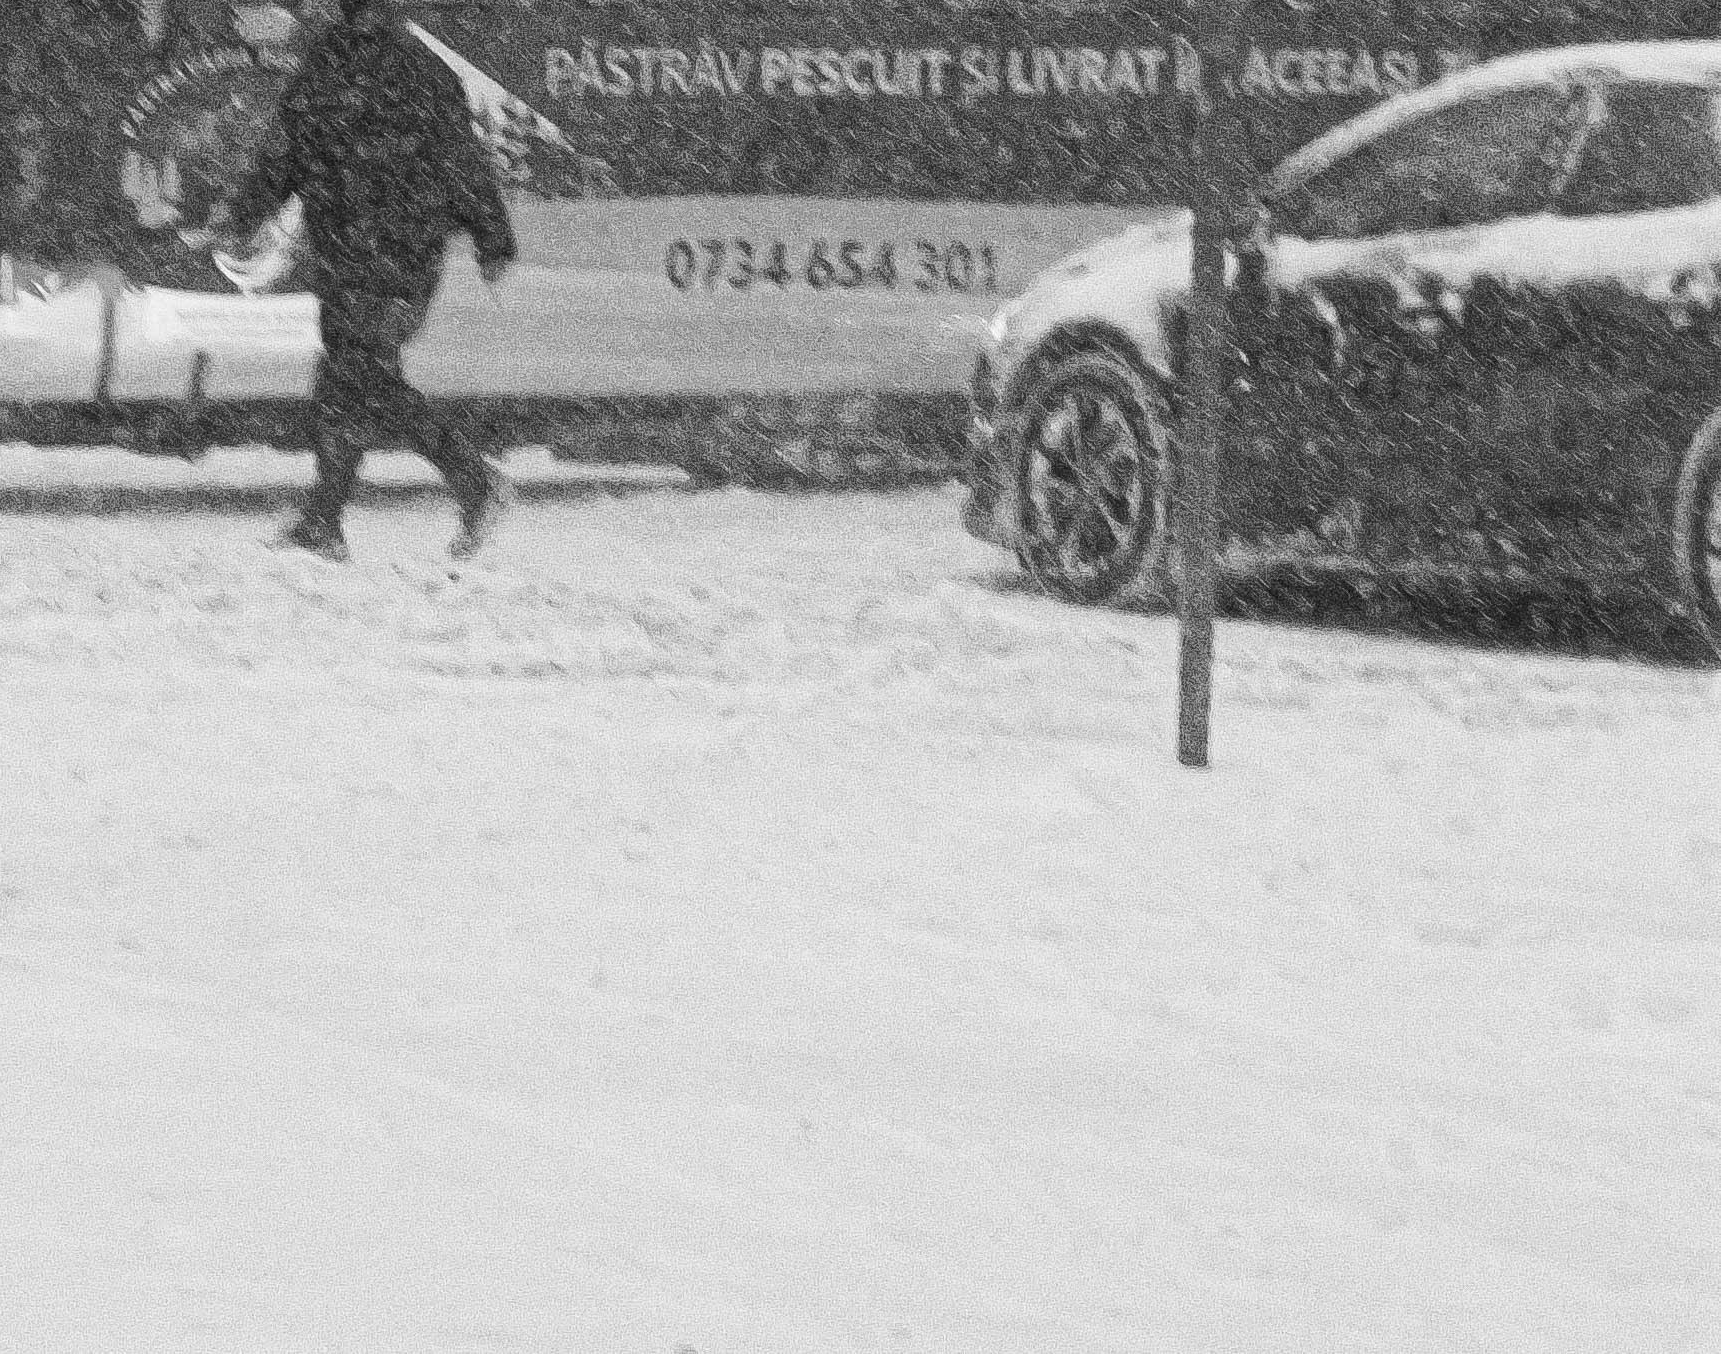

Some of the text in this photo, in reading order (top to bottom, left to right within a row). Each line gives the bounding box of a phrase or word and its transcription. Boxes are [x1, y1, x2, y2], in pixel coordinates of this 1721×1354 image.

[544, 37, 752, 95] PĂSTRĂV
[761, 45, 949, 95] PESCUIT
[1006, 46, 1168, 96] LIVRAT
[665, 239, 1000, 292] 0734 654 301
